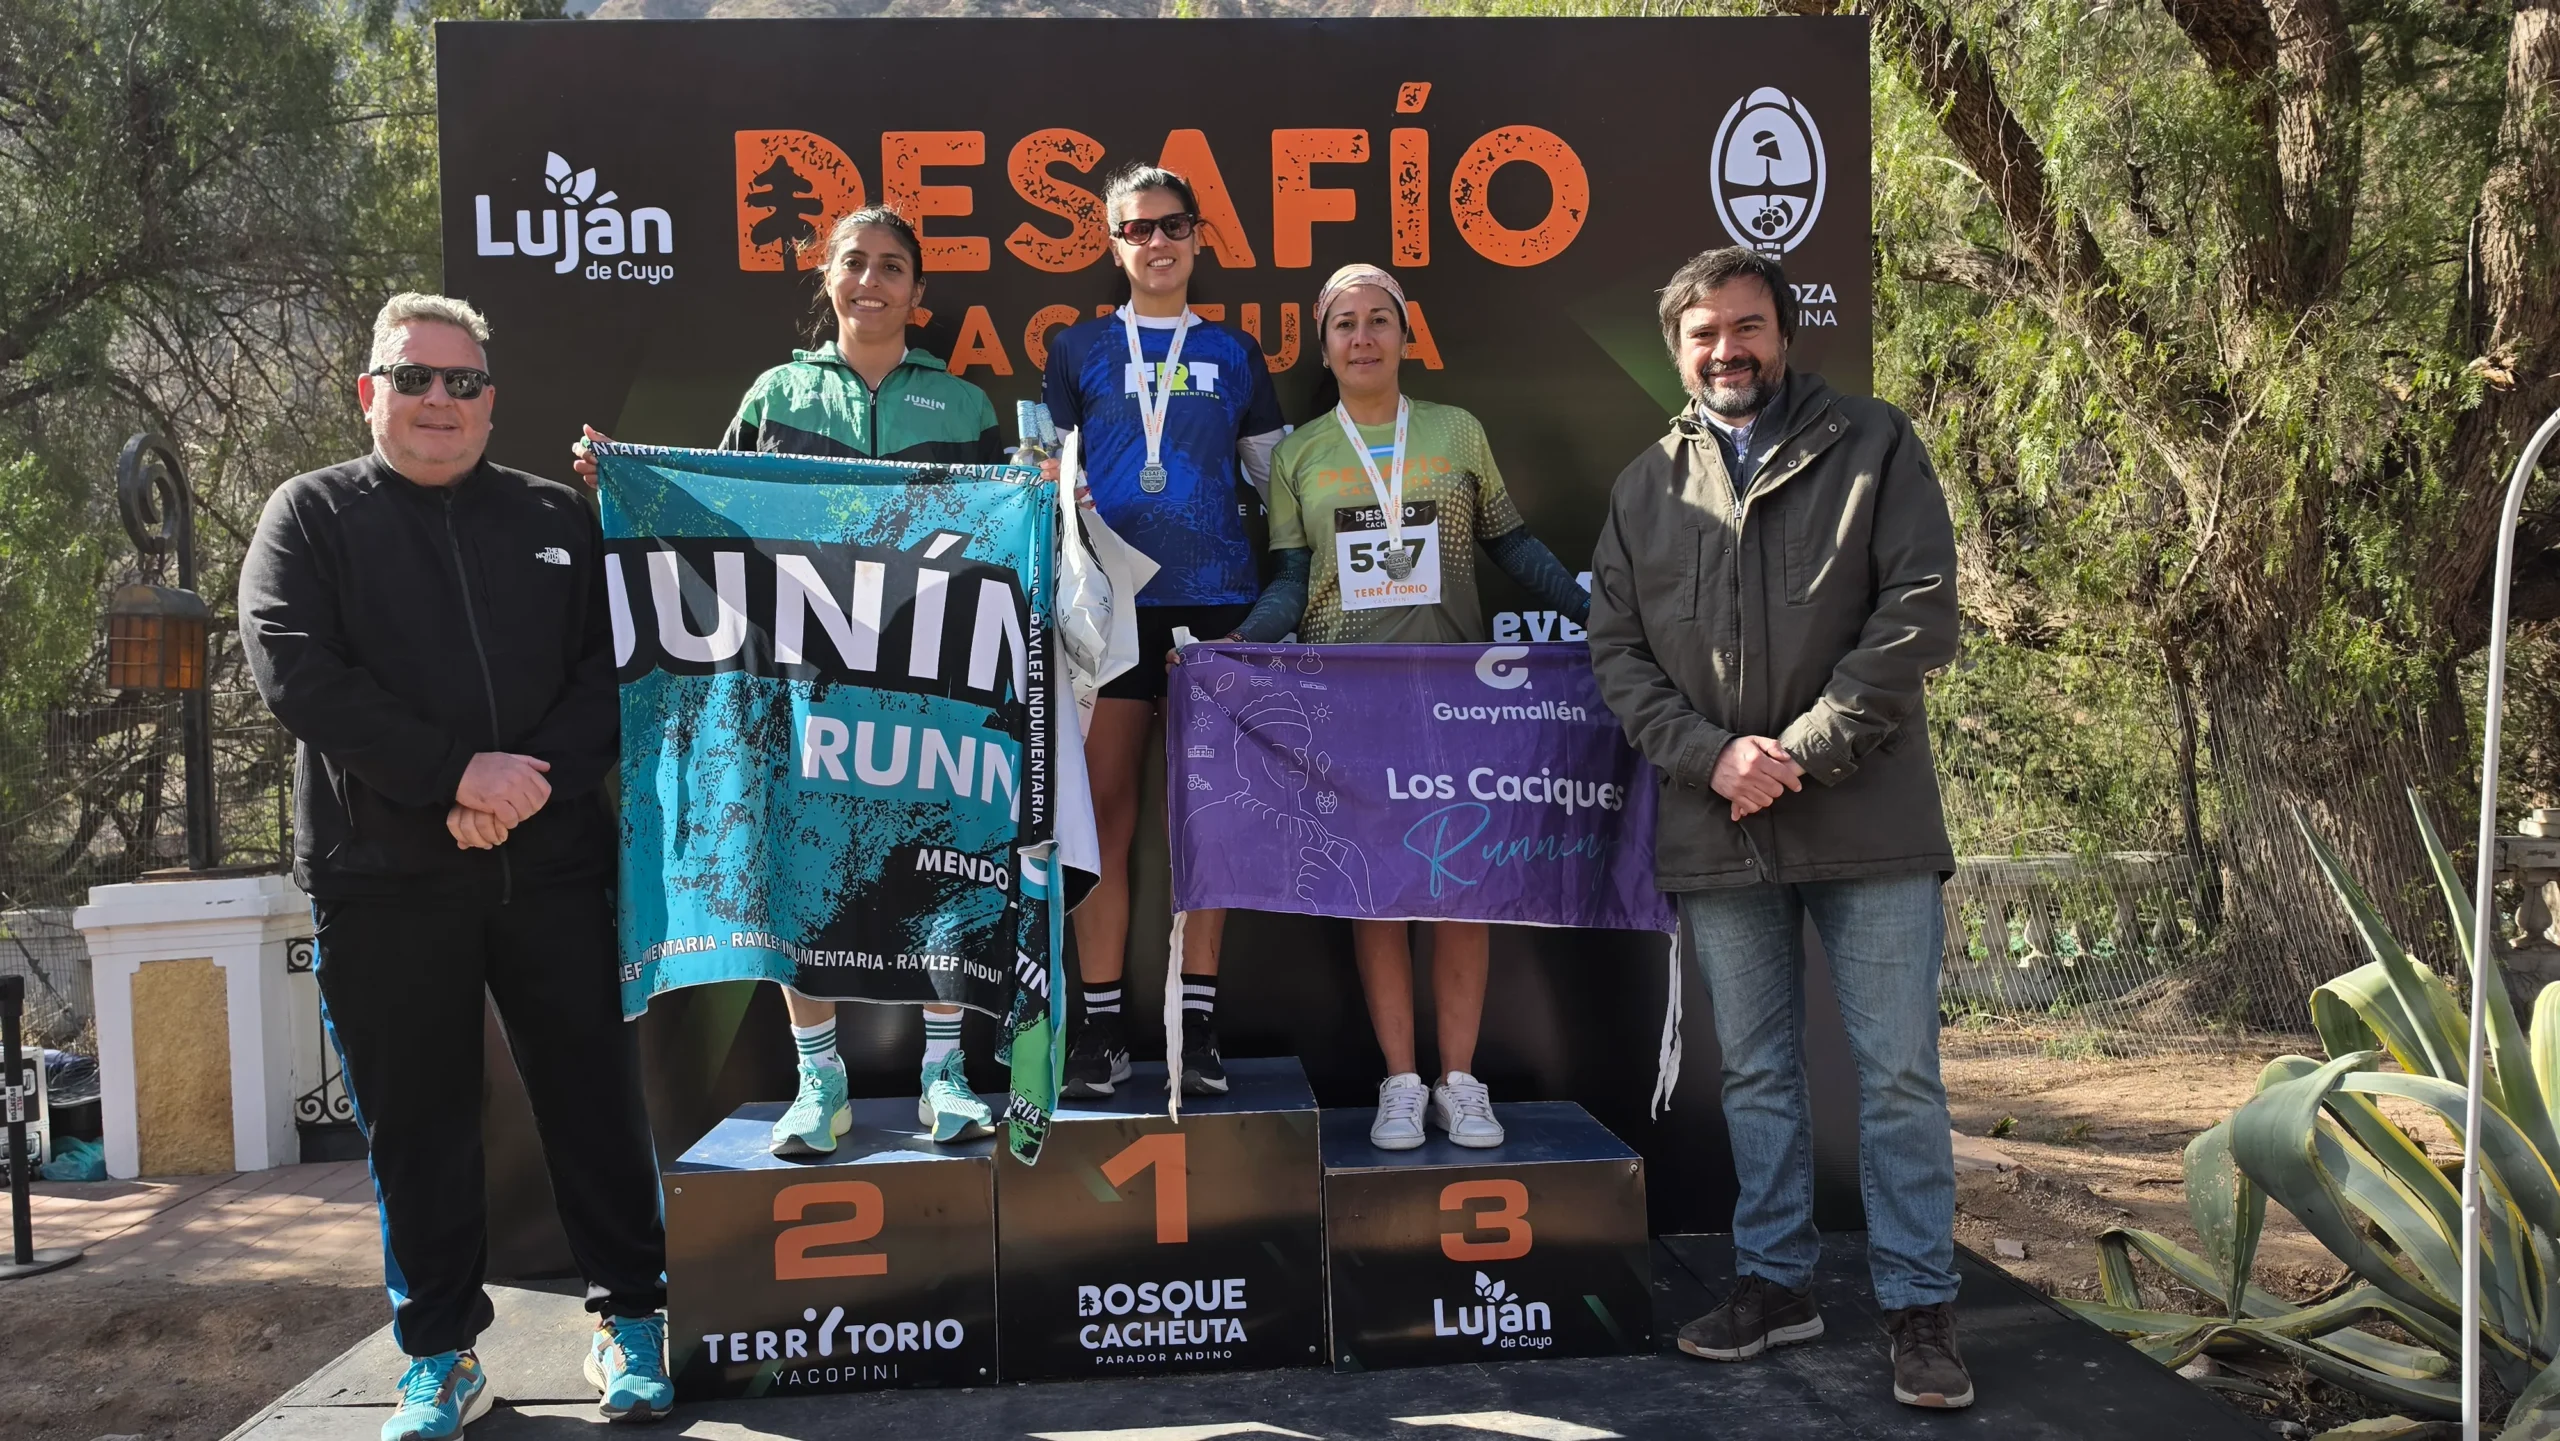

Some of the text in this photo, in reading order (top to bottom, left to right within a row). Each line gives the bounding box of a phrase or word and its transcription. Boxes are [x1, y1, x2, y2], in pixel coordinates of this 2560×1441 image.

[735, 82, 1590, 272] DESAFÍO
[475, 190, 673, 274] Luján
[585, 261, 674, 285] de Cuyo
[1125, 362, 1219, 393] FRT
[904, 394, 945, 410] JUNÍN
[950, 463, 1031, 483] RAYLEF
[1027, 612, 1044, 681] RAYLEF
[1433, 701, 1587, 724] Guaymallén
[1028, 685, 1045, 825] INDUMENTARIA
[1386, 767, 1624, 816] Los Caciques
[732, 931, 781, 950] RAYLEF
[898, 953, 960, 972] RAYLEF
[1100, 1132, 1188, 1244] 1
[773, 1180, 888, 1281] 2
[1439, 1178, 1533, 1262] 3
[1078, 1278, 1247, 1318] BOSQUE
[1079, 1317, 1248, 1350] CACHEUTA
[1433, 1292, 1551, 1345] Luján
[1096, 1350, 1233, 1365] PARADOR ANDINO
[1500, 1335, 1552, 1349] de Cuyo
[772, 1364, 899, 1386] YACOPINI
